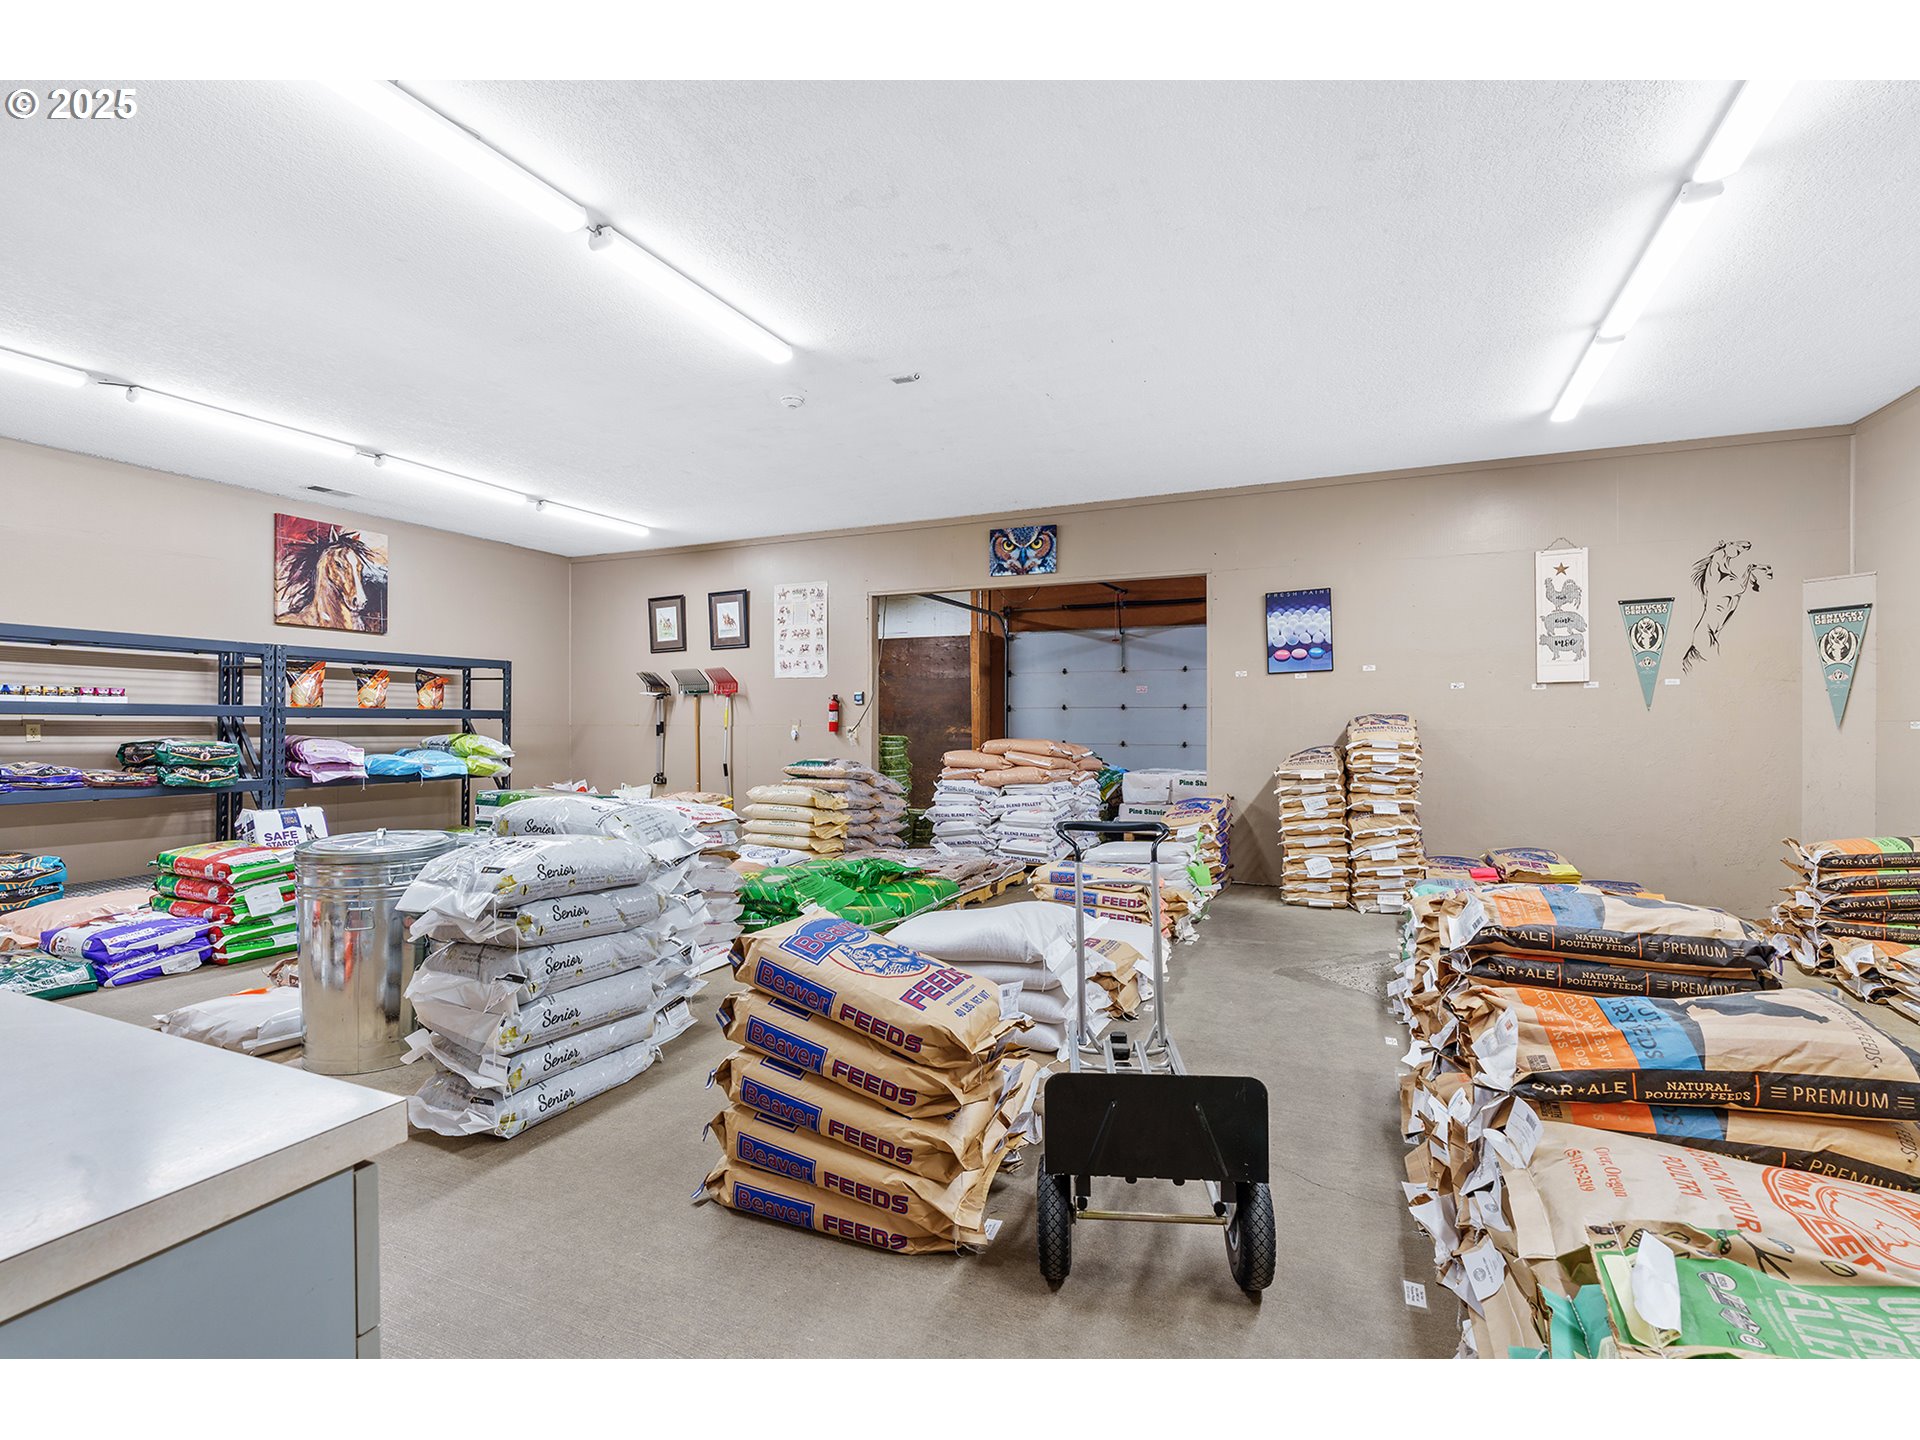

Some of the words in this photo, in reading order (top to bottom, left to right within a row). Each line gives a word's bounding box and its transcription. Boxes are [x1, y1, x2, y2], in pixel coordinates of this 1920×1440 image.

[1624, 603, 1668, 611] KENTUCKY
[1814, 610, 1864, 620] KENTUCKY
[1814, 617, 1845, 625] DERBY
[1178, 779, 1194, 787] Pine
[1128, 807, 1144, 815] Pine
[263, 830, 299, 842] SAFE
[524, 818, 557, 835] Senior
[265, 840, 300, 848] STARCH
[536, 863, 577, 881] Senior
[1055, 888, 1097, 905] Beaer
[1101, 895, 1144, 909] FEEDS
[1839, 901, 1860, 909] BAR
[552, 903, 590, 922] Senior
[793, 918, 866, 955] Beav
[1479, 927, 1509, 938] BAR
[1518, 931, 1549, 942] ALE
[1834, 927, 1855, 935] BAR
[1860, 930, 1882, 938] ALE
[1559, 939, 1604, 951] POULTRY
[1606, 943, 1637, 954] FEEDS
[1574, 933, 1622, 946] NATURAL
[1662, 942, 1728, 959] PREMIUM
[544, 953, 583, 975] Senior
[1487, 962, 1516, 976] BAR
[1524, 968, 1556, 981] ALE
[1566, 977, 1611, 988] POULTRY
[1612, 981, 1644, 993] FEEDS
[1581, 971, 1629, 983] NATURAL
[1671, 980, 1736, 995] PREMIUM
[541, 1006, 582, 1028] Senior
[758, 963, 829, 1014] Beaver
[839, 1002, 924, 1053] FEEDS
[954, 1007, 967, 1018] 40
[1857, 1031, 1883, 1065] FEEDS
[542, 1047, 581, 1072] Senior
[749, 1023, 820, 1071] Beaver
[831, 1059, 917, 1106] FEEDS
[1531, 1082, 1574, 1097] BAR
[1586, 1081, 1628, 1096] ALE
[1645, 1090, 1708, 1101] POULTRY
[1710, 1091, 1751, 1101] FEEDS
[1666, 1081, 1733, 1093] NATURAL
[1792, 1086, 1890, 1109] PREMIUM
[537, 1085, 577, 1113] Senior
[745, 1083, 816, 1129] Beaver
[827, 1119, 913, 1166] FEEDS
[740, 1138, 812, 1181] Beaver
[823, 1171, 909, 1215] FEEDS
[1603, 1165, 1628, 1198] Oregon
[1658, 1153, 1708, 1201] POULTRY
[1808, 1158, 1914, 1193] PREMI
[1713, 1183, 1763, 1233] NATUR
[1783, 1194, 1817, 1211] &
[736, 1188, 810, 1227] Beaver
[822, 1214, 909, 1250] FEEDS
